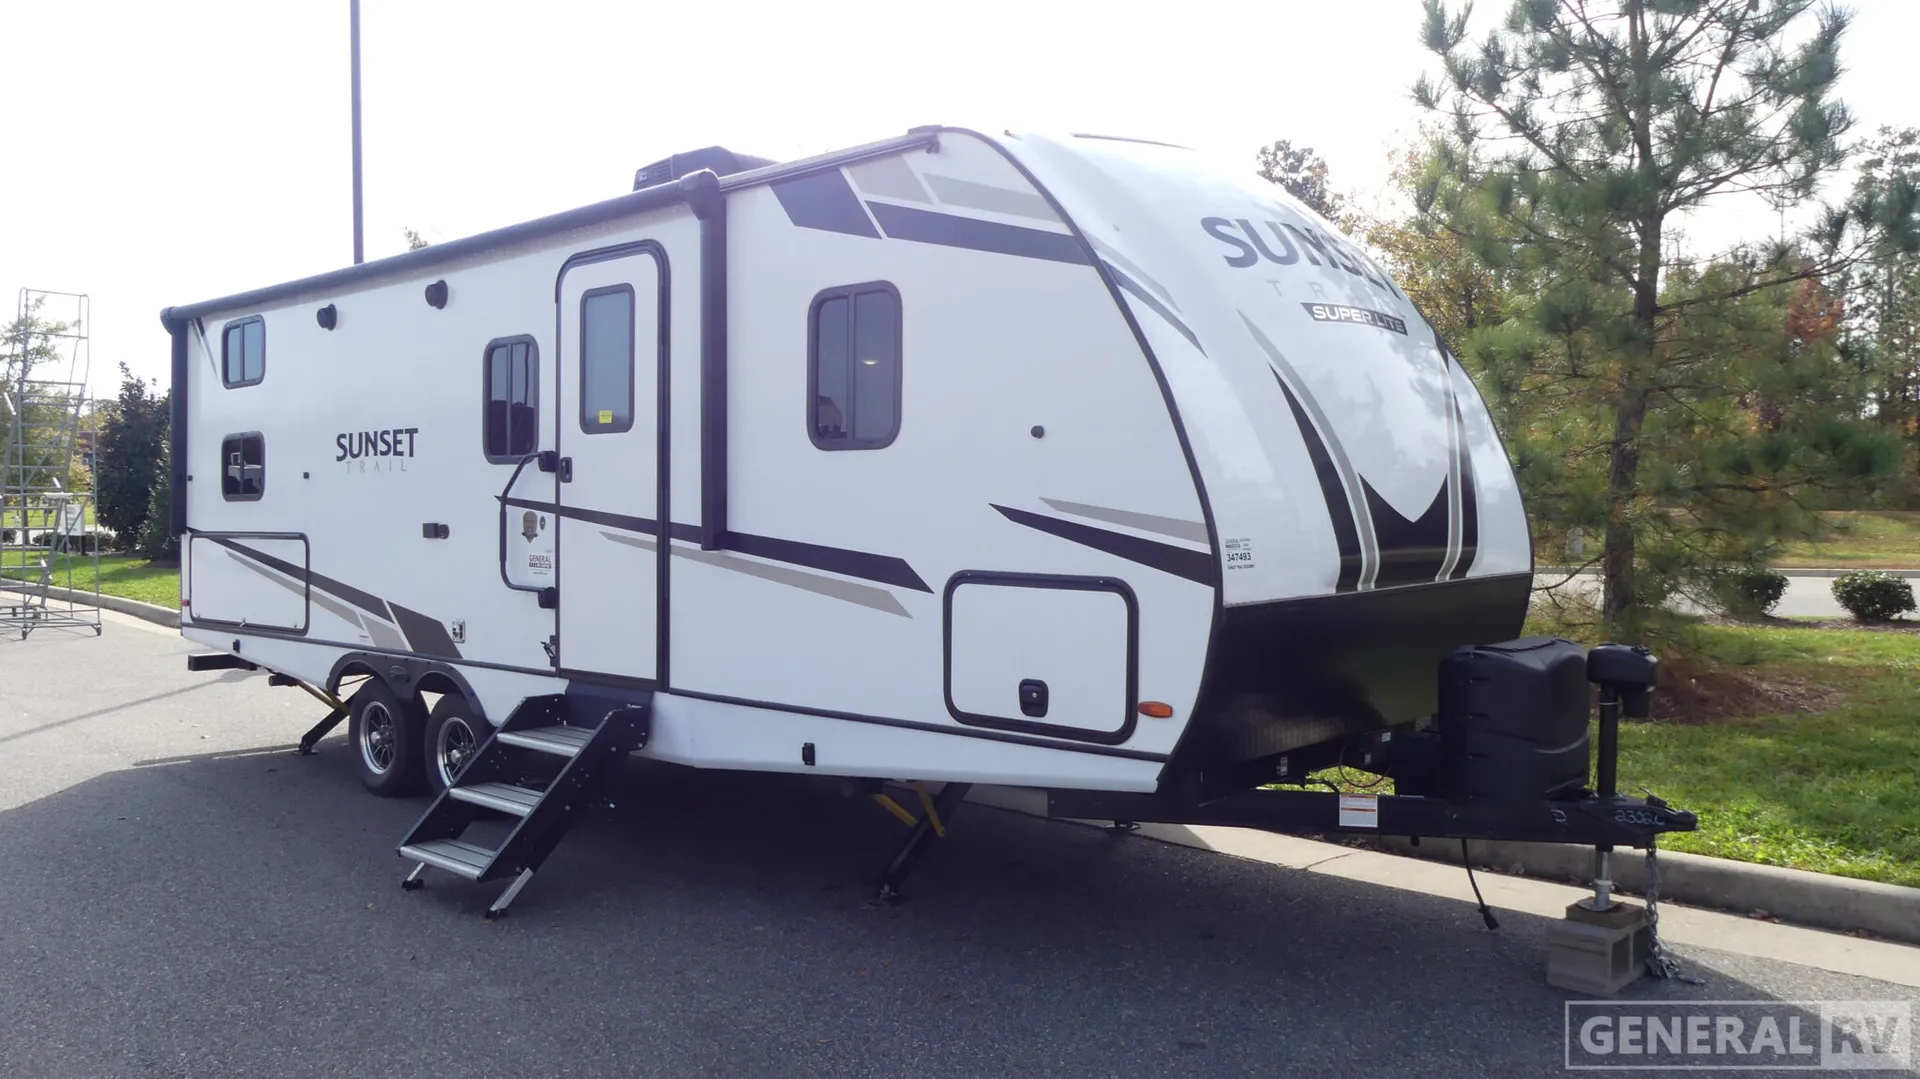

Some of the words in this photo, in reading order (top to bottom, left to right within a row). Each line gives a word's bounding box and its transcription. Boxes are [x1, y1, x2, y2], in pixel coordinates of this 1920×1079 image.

[1312, 304, 1374, 325] SUPER
[1374, 312, 1405, 333] LITE
[336, 427, 419, 462] SUNSET
[345, 457, 407, 474] TRAIL
[1226, 551, 1252, 563] 347493
